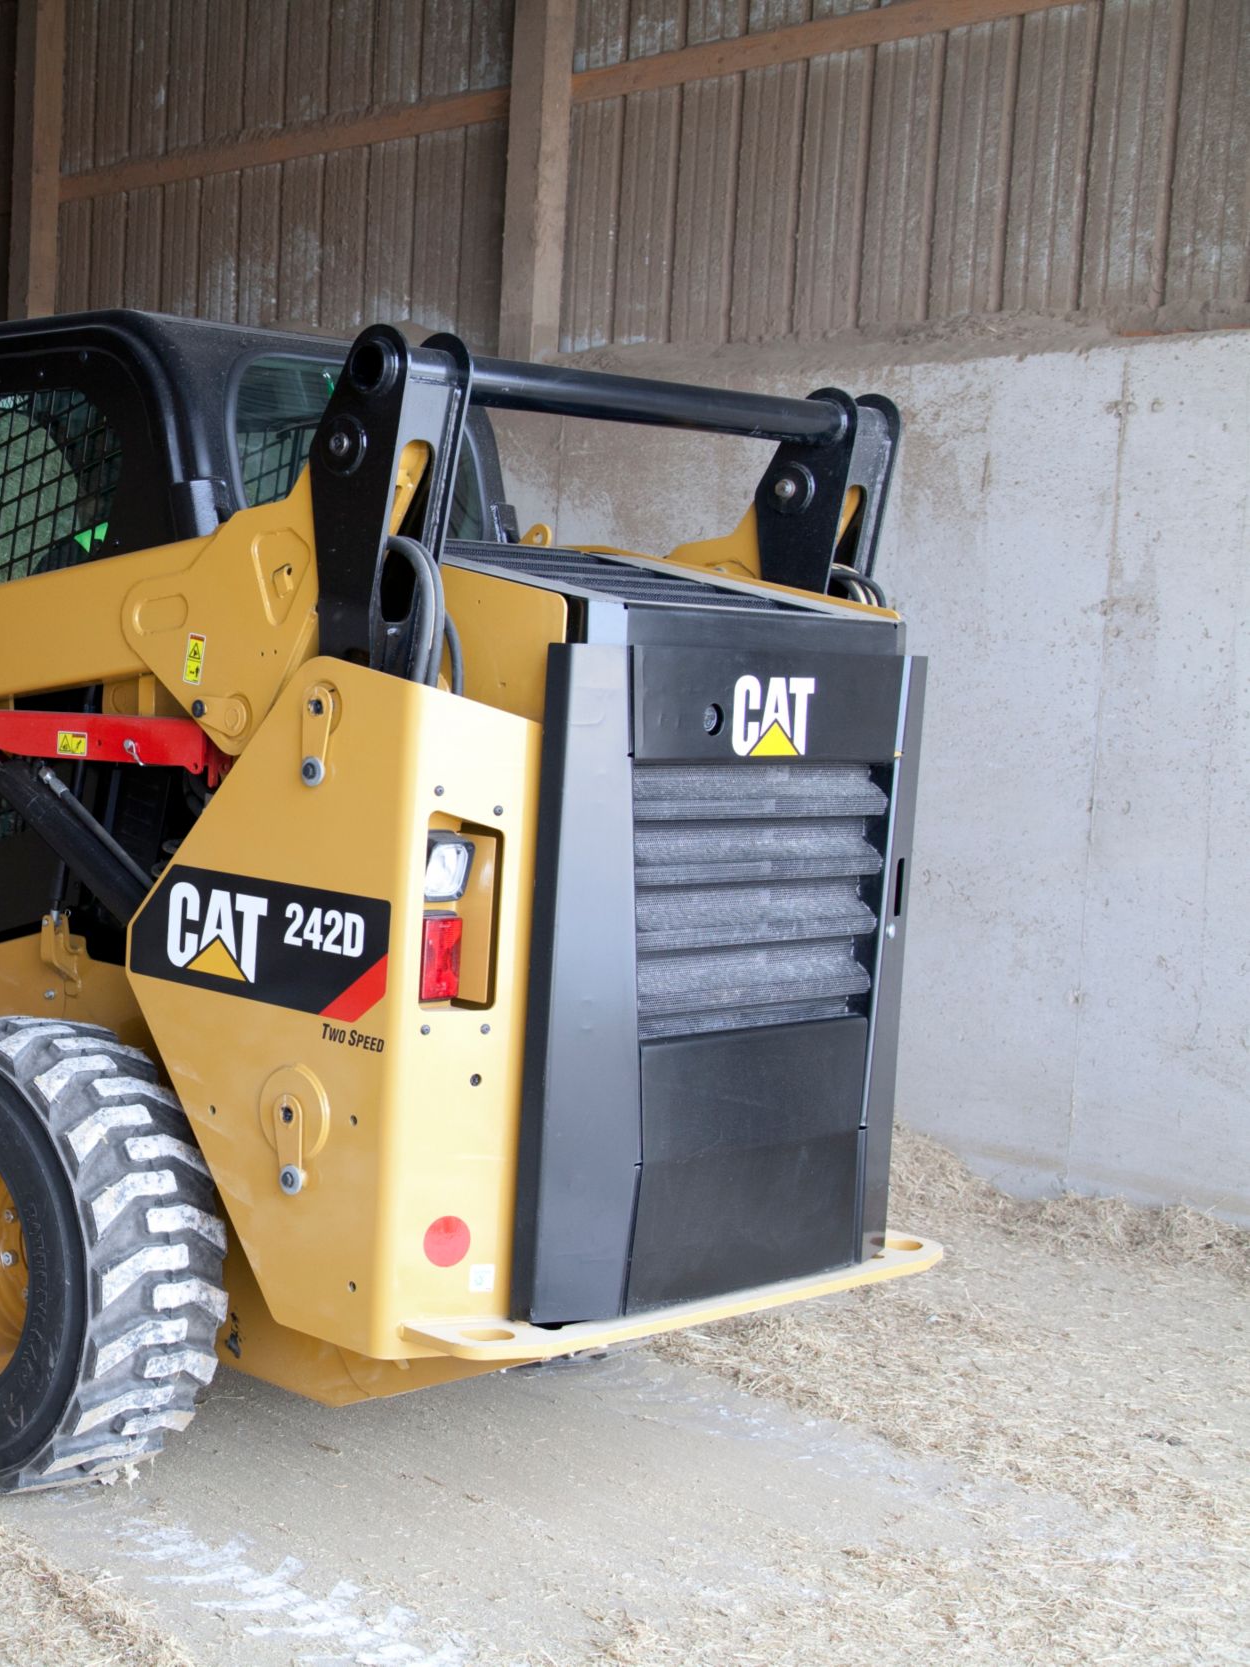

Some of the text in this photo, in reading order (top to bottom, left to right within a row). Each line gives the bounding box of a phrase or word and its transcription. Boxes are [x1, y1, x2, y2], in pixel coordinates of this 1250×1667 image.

[732, 674, 815, 757] CAT
[166, 881, 365, 984] CAT 242D
